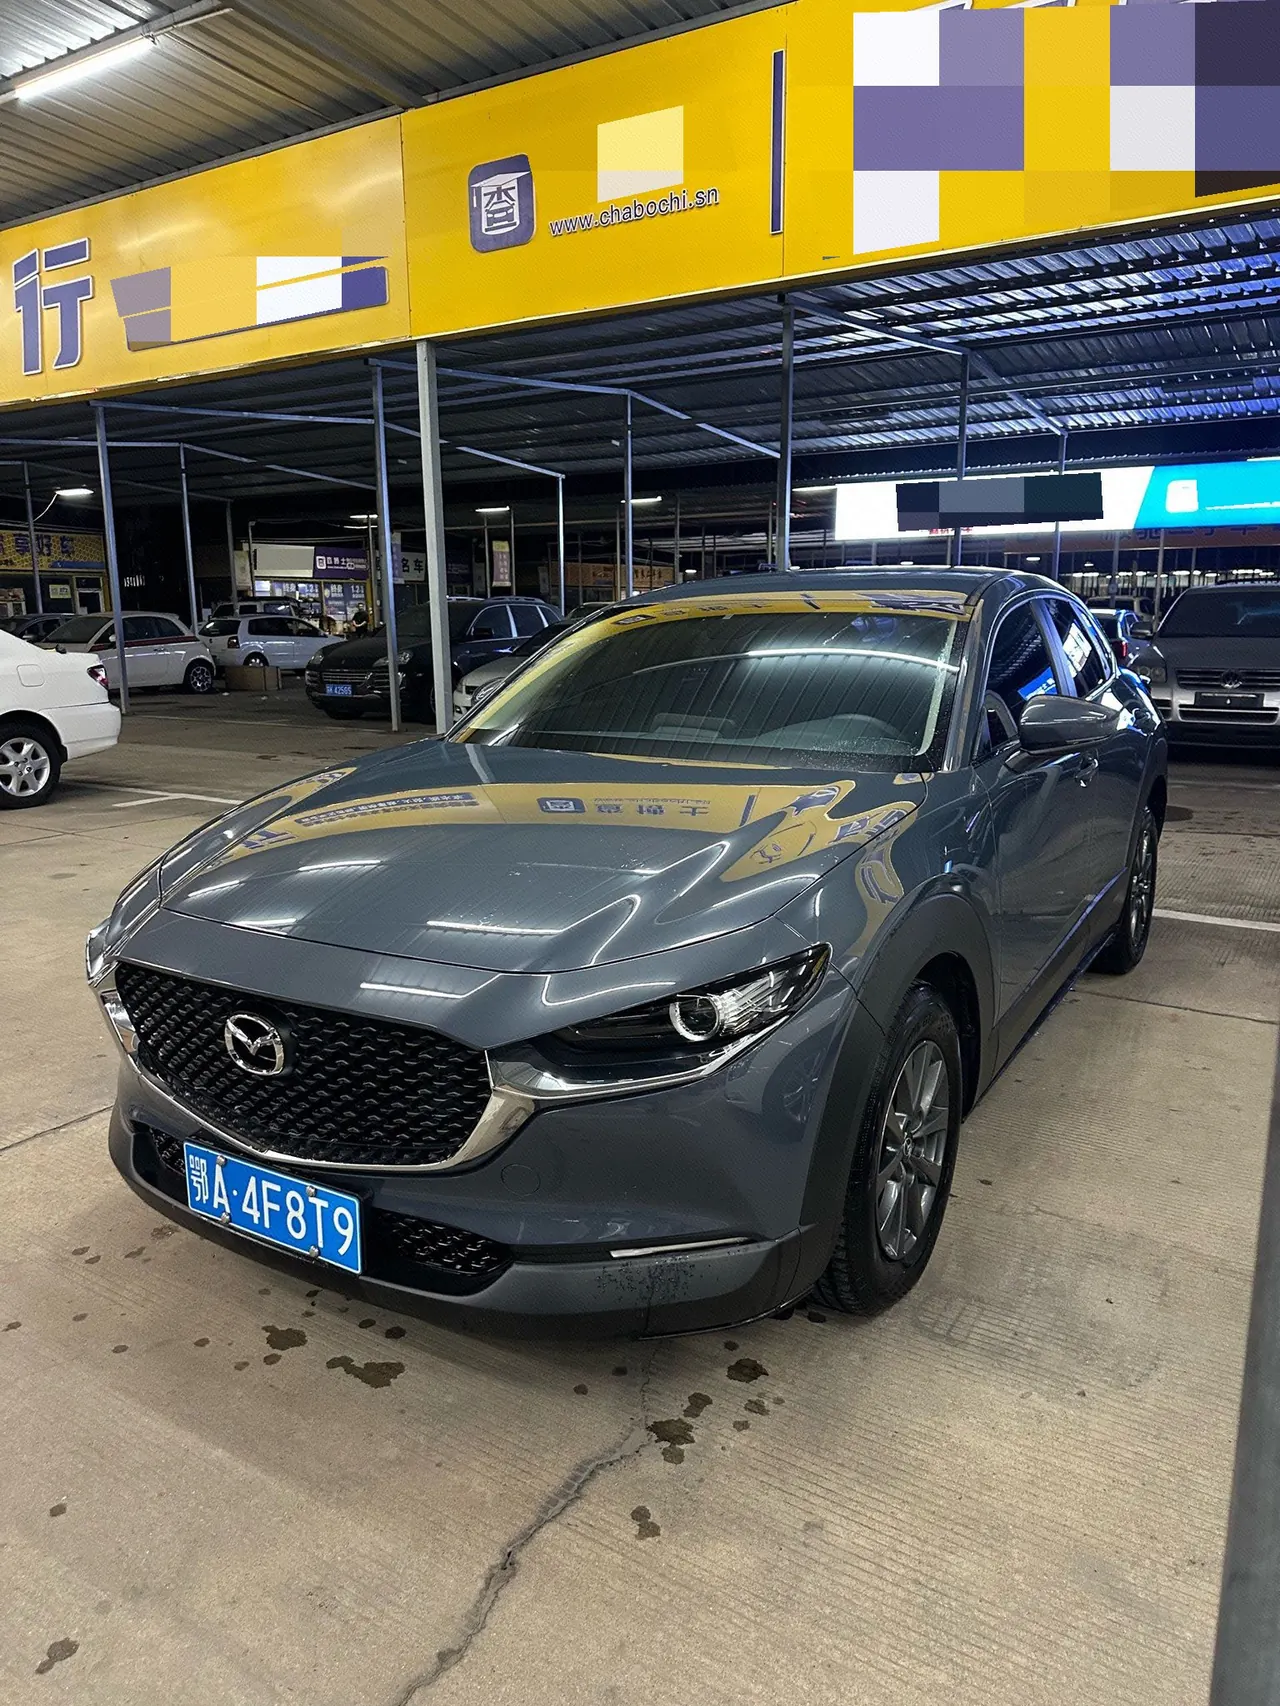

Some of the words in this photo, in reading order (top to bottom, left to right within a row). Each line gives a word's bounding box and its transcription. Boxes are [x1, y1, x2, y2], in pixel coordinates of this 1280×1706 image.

[549, 188, 719, 236] www.chabochi.sn
[13, 237, 94, 375] 行
[402, 557, 424, 574] 名车
